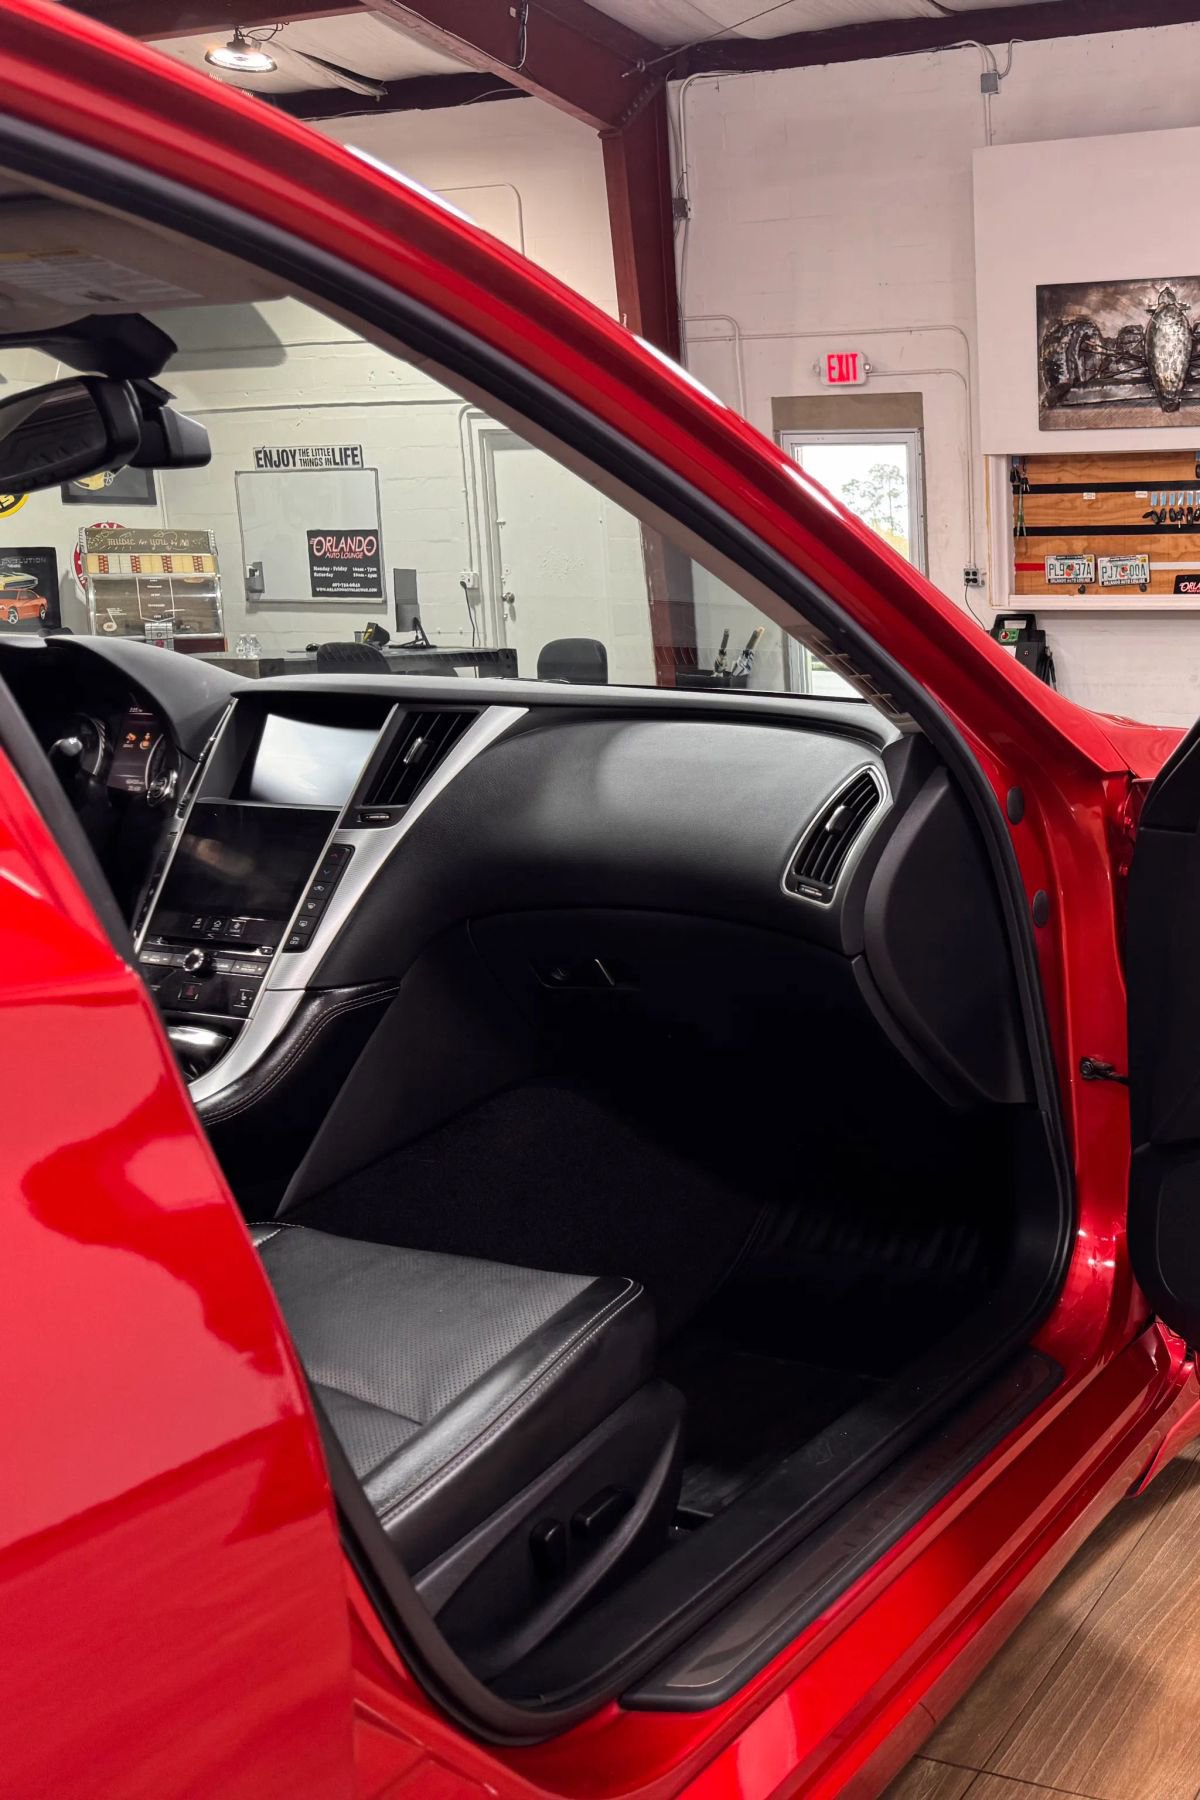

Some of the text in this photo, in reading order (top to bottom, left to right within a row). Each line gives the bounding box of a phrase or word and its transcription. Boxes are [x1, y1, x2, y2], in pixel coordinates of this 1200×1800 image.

[827, 353, 858, 383] EXIT
[255, 449, 297, 468] ENJOY
[298, 448, 331, 457] THE LITTLE
[299, 457, 332, 467] THINGS IN
[331, 447, 360, 466] LIFE
[313, 536, 377, 556] ORLANDO
[325, 551, 364, 559] AUTO LOUNGE
